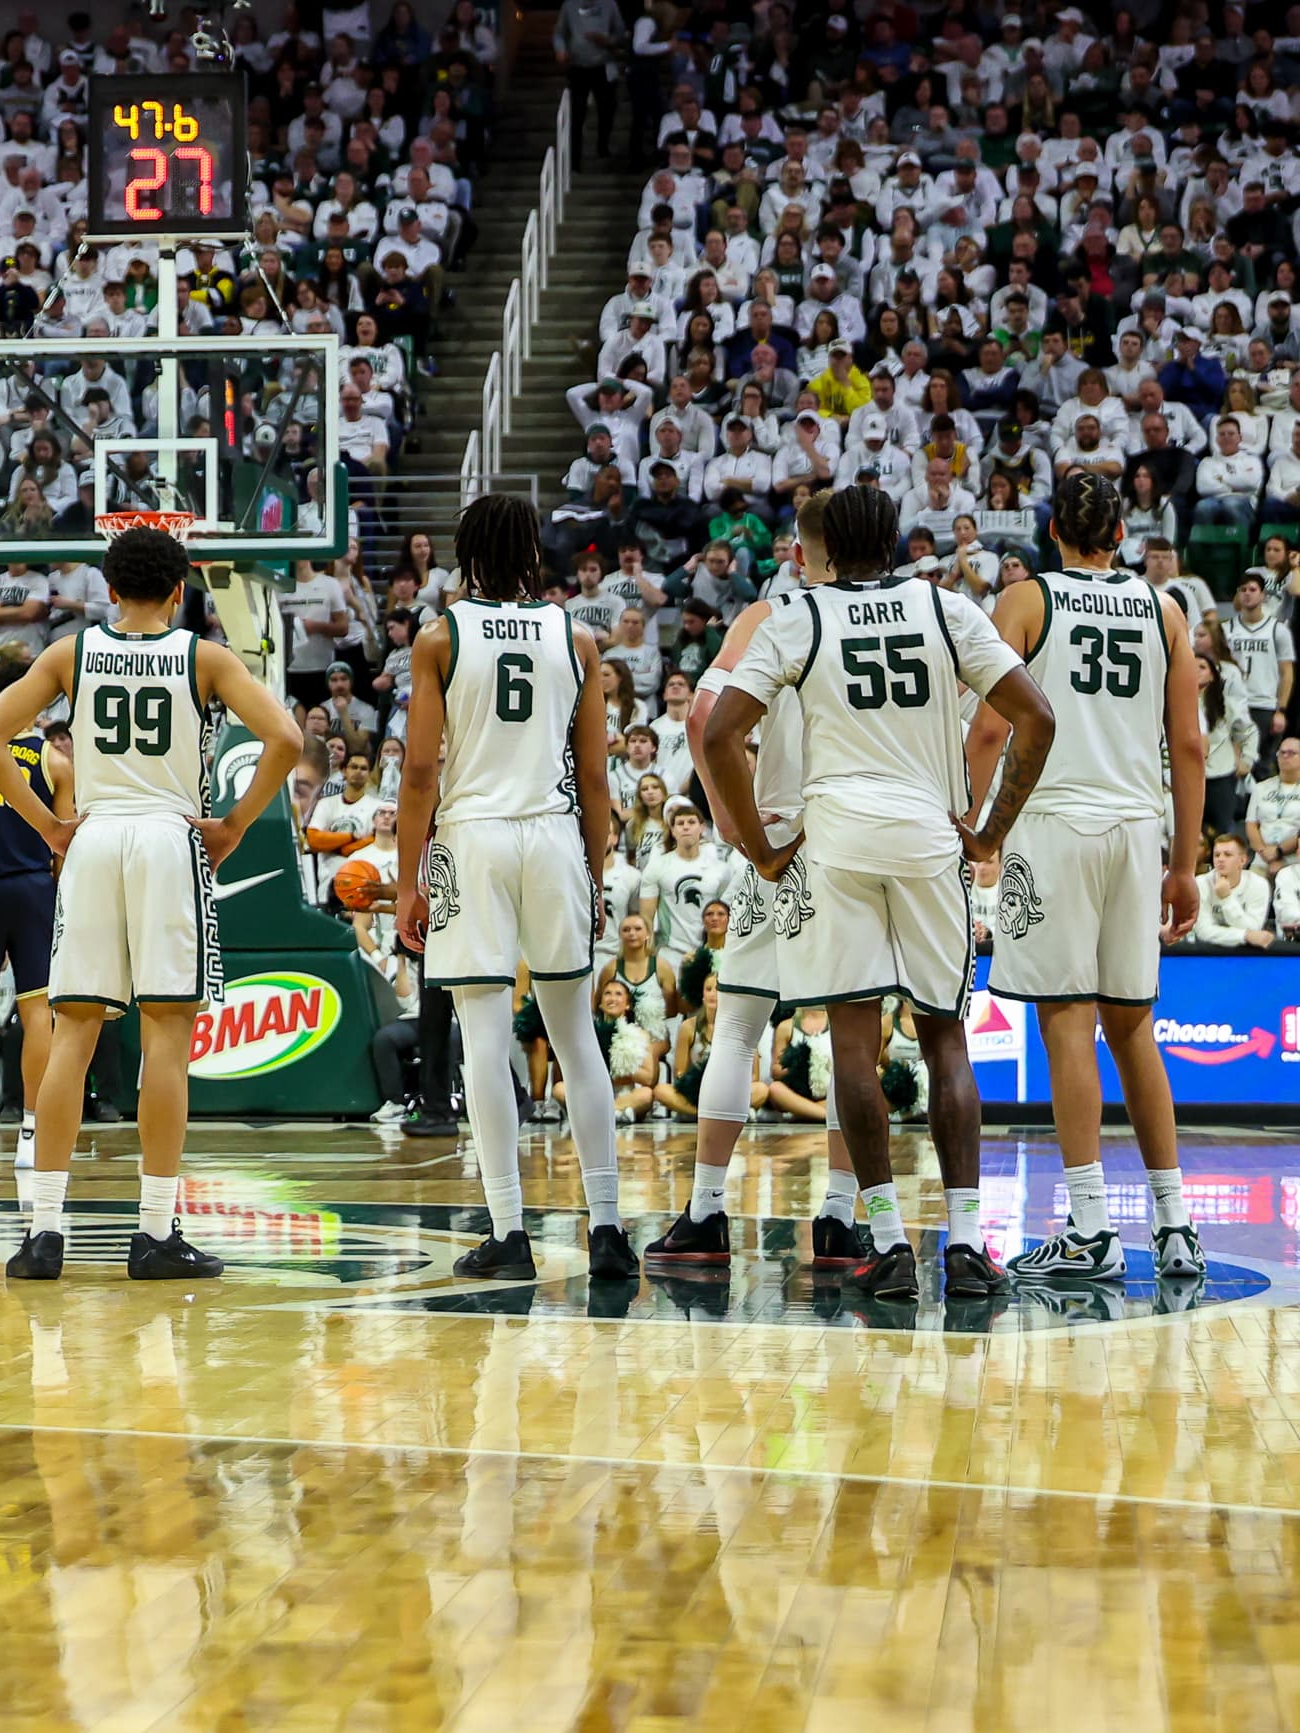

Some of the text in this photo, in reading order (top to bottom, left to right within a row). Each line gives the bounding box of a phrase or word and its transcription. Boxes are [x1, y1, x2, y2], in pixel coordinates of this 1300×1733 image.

[113, 100, 200, 142] 47.6
[123, 145, 215, 221] 27
[482, 619, 543, 641] SCOTT
[847, 600, 908, 627] CARR
[1052, 591, 1155, 619] McCULLOCH
[85, 652, 186, 677] UGOCHUKWU
[495, 652, 534, 723] 6
[841, 633, 931, 711] 55
[1069, 624, 1143, 699] 35
[93, 685, 173, 757] 99
[189, 988, 322, 1063] BMAN
[1152, 1018, 1250, 1043] Choose...
